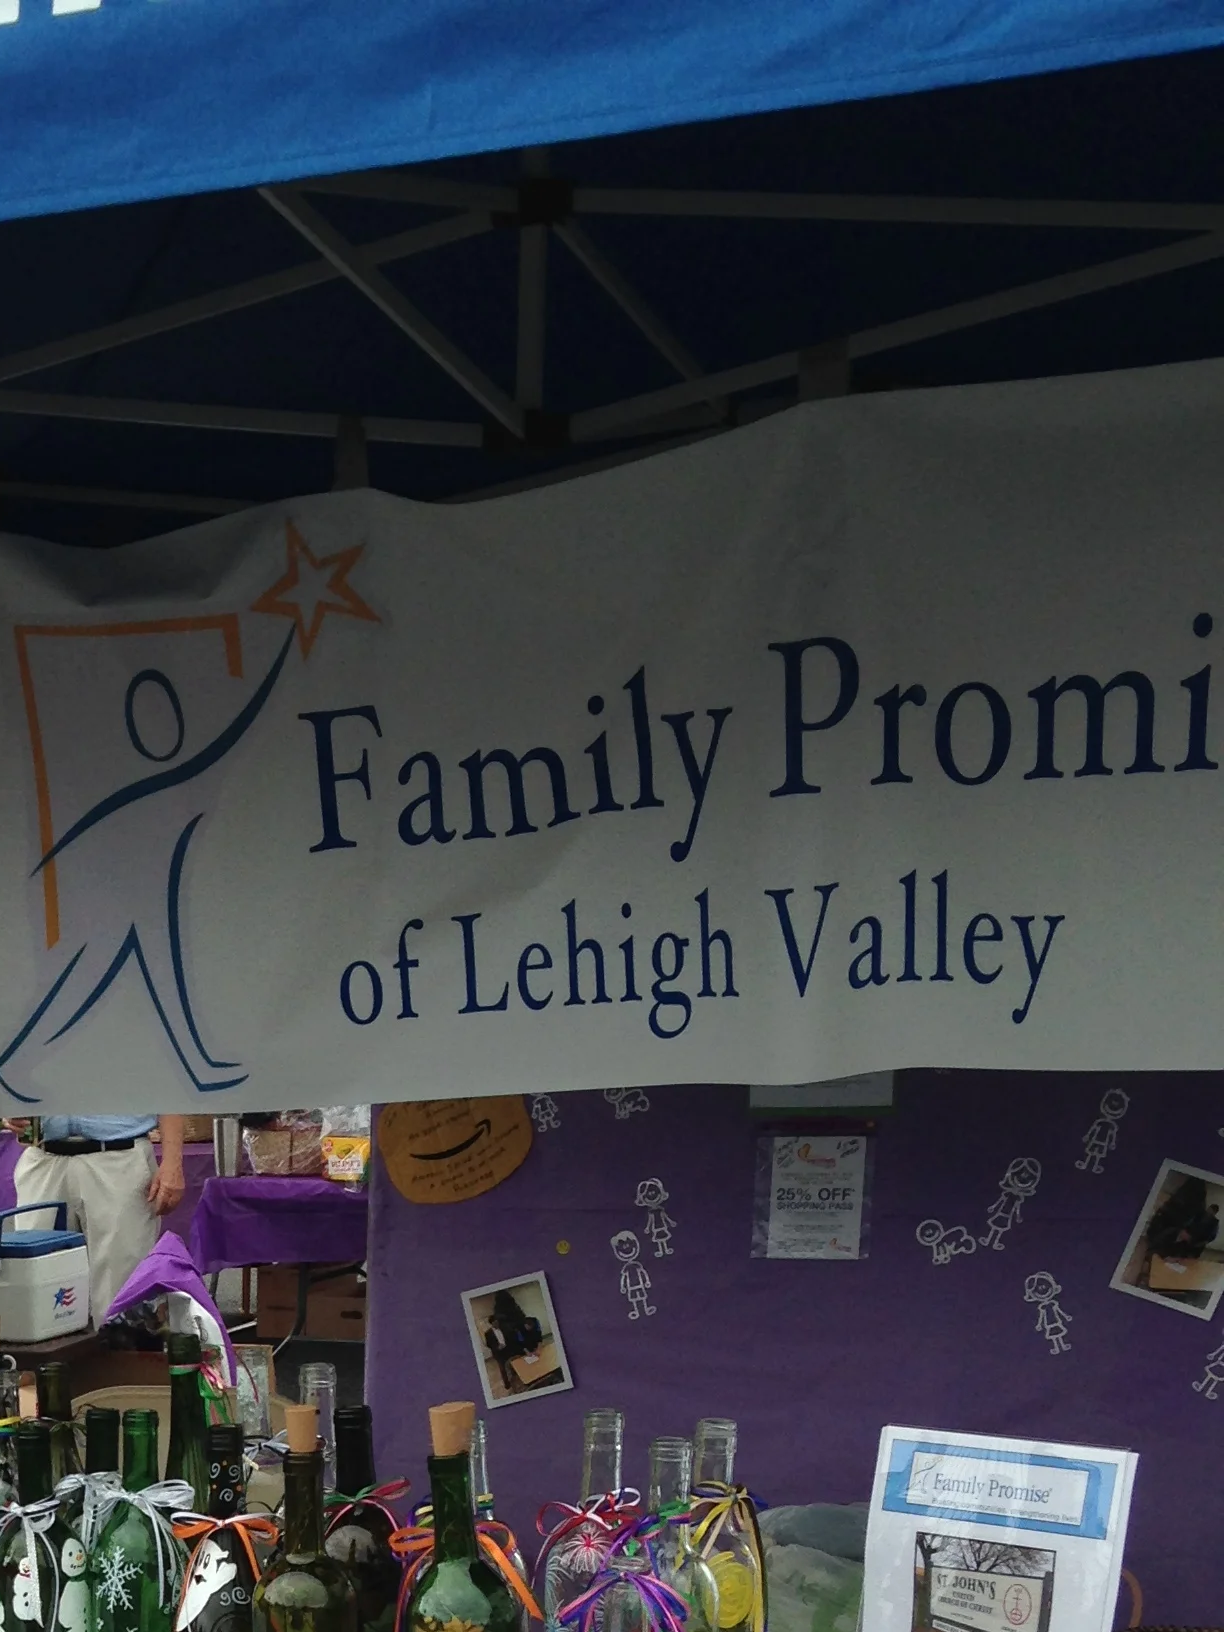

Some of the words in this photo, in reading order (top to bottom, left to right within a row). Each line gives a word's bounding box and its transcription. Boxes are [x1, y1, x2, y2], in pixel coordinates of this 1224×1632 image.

[297, 664, 734, 863] Family
[767, 612, 1219, 799] Promi
[340, 917, 426, 1026] of
[450, 887, 740, 1040] Lehigh
[764, 868, 1066, 1025] Valley
[776, 1187, 812, 1201] 25%
[932, 1472, 985, 1500] Family
